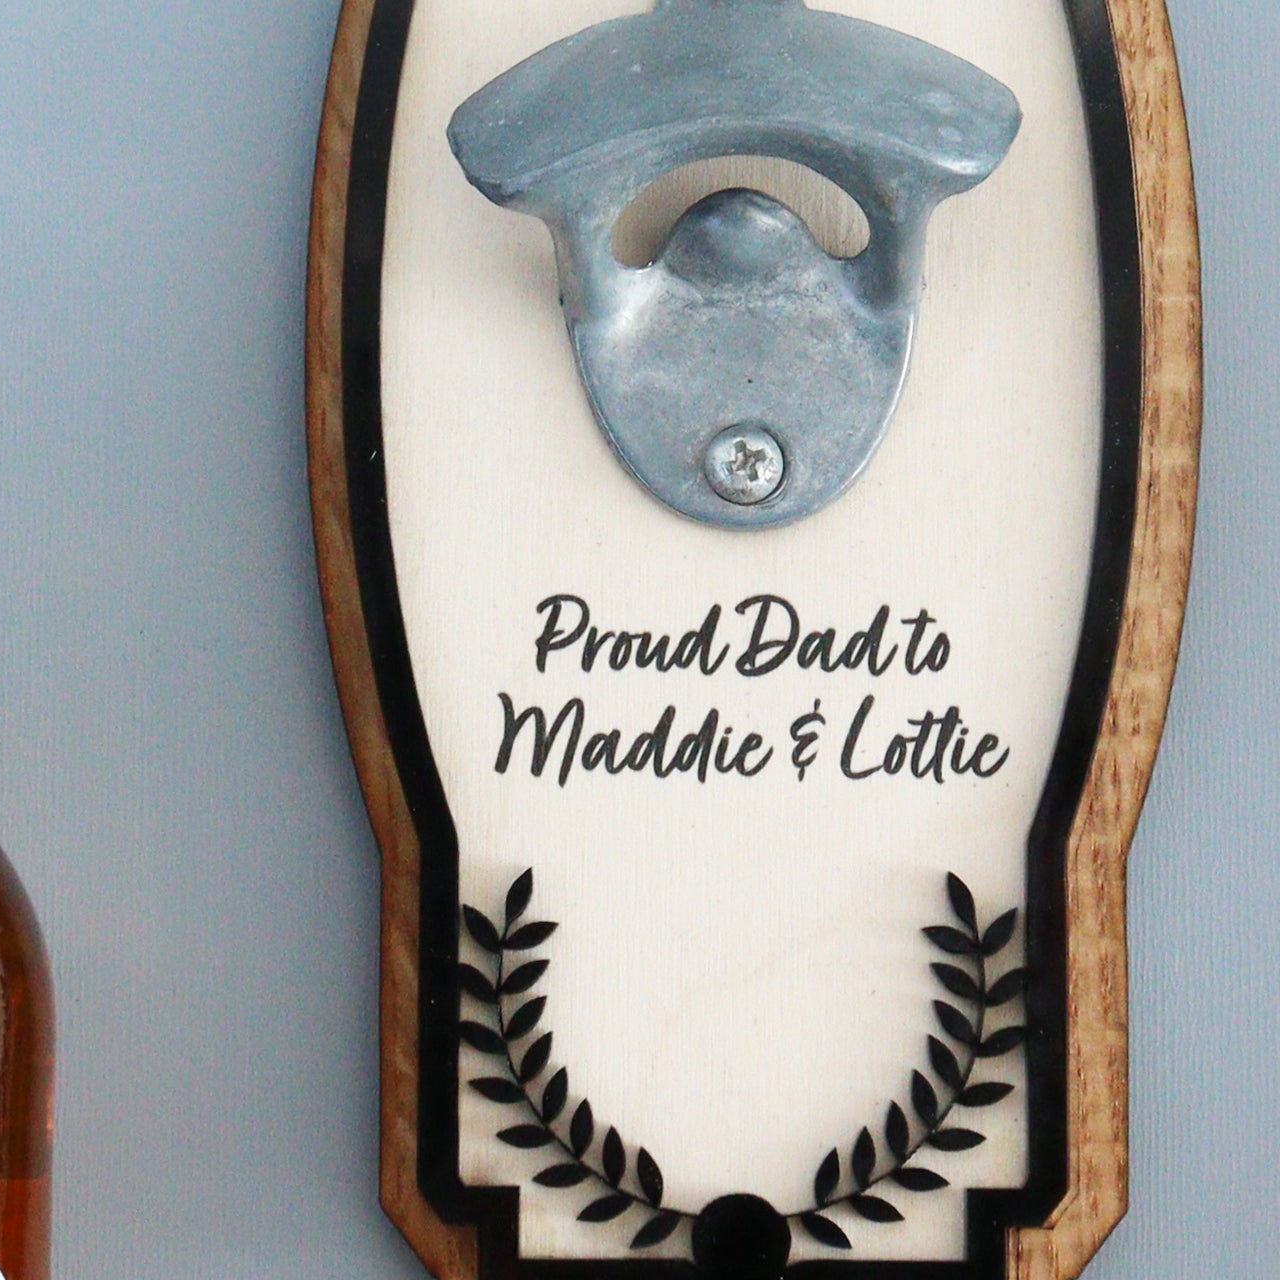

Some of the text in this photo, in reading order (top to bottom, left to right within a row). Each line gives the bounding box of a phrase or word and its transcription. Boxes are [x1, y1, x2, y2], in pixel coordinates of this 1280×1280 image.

[535, 593, 952, 678] Proud Dad to
[493, 692, 1011, 789] Maddie & Lottie
